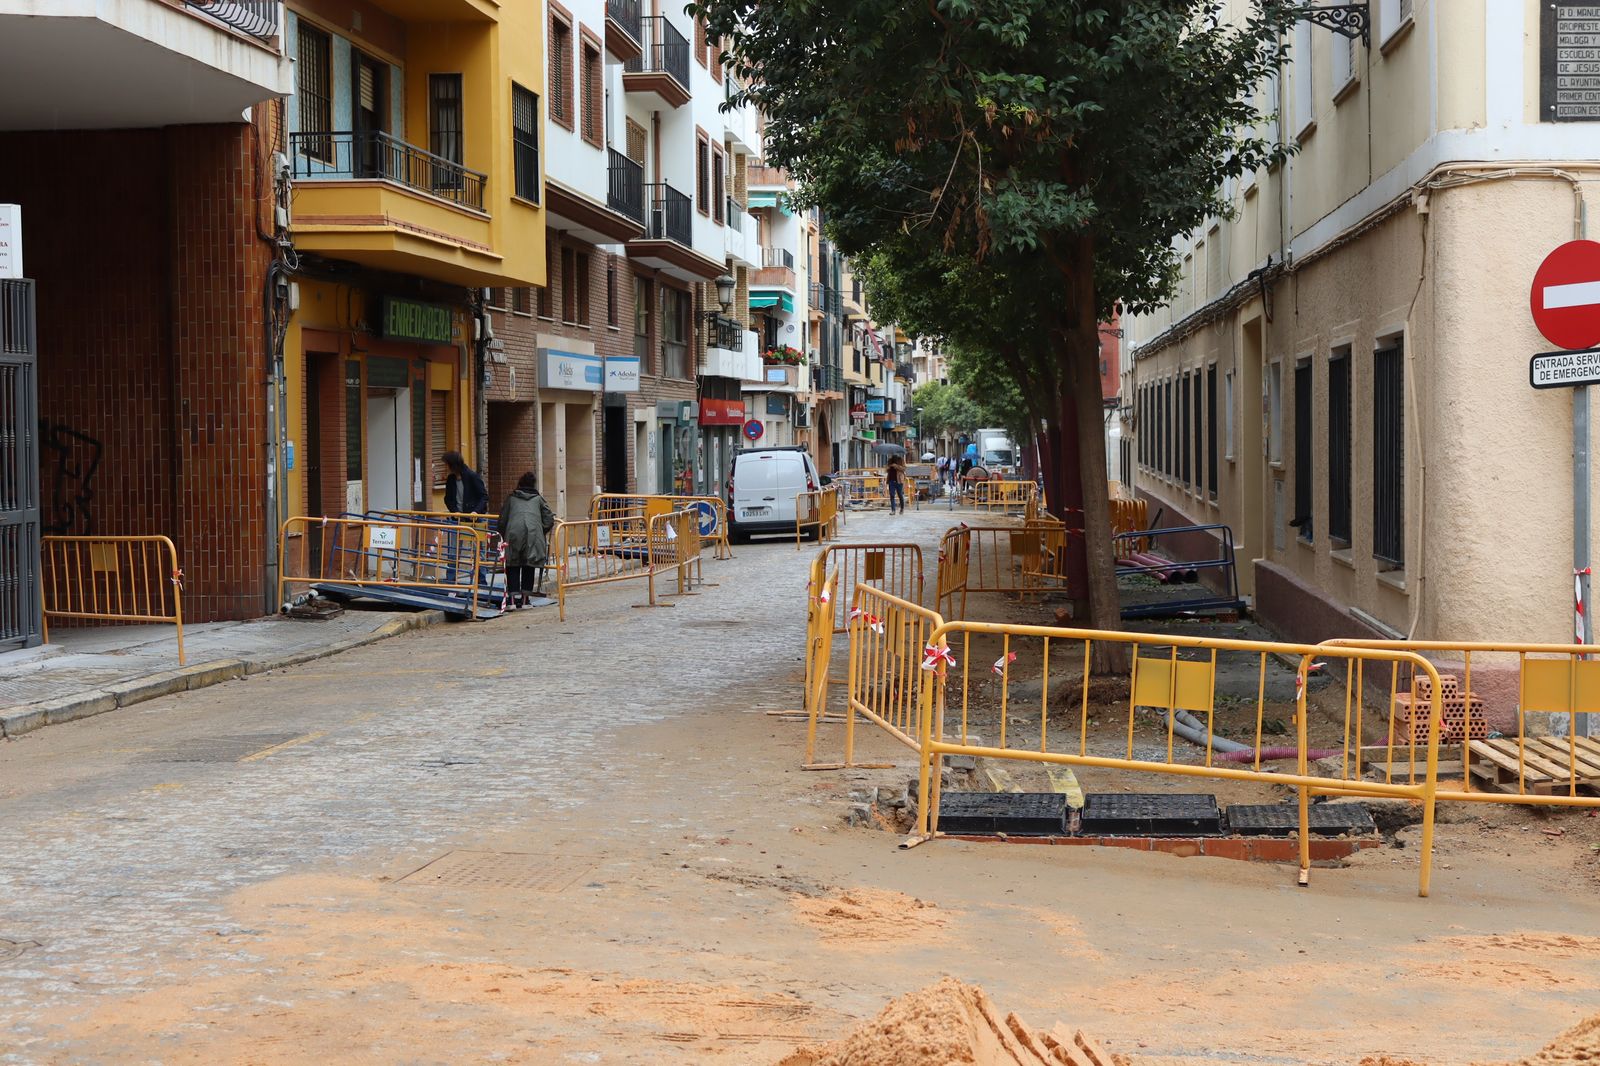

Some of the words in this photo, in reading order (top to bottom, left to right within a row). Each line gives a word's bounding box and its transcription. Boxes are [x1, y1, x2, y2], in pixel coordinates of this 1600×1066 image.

[1559, 22, 1599, 31] ARCIPRESTE
[1559, 36, 1589, 45] MALAGA
[1591, 36, 1597, 45] Y
[1559, 50, 1595, 59] ESCUELAS
[1559, 63, 1570, 73] DE
[1573, 63, 1599, 73] JESUS
[1559, 78, 1568, 87] EL
[1559, 92, 1582, 101] PRIMER
[389, 300, 451, 341] ENREDADERA
[1534, 356, 1574, 370] ENTRADA
[1540, 370, 1551, 381] DE
